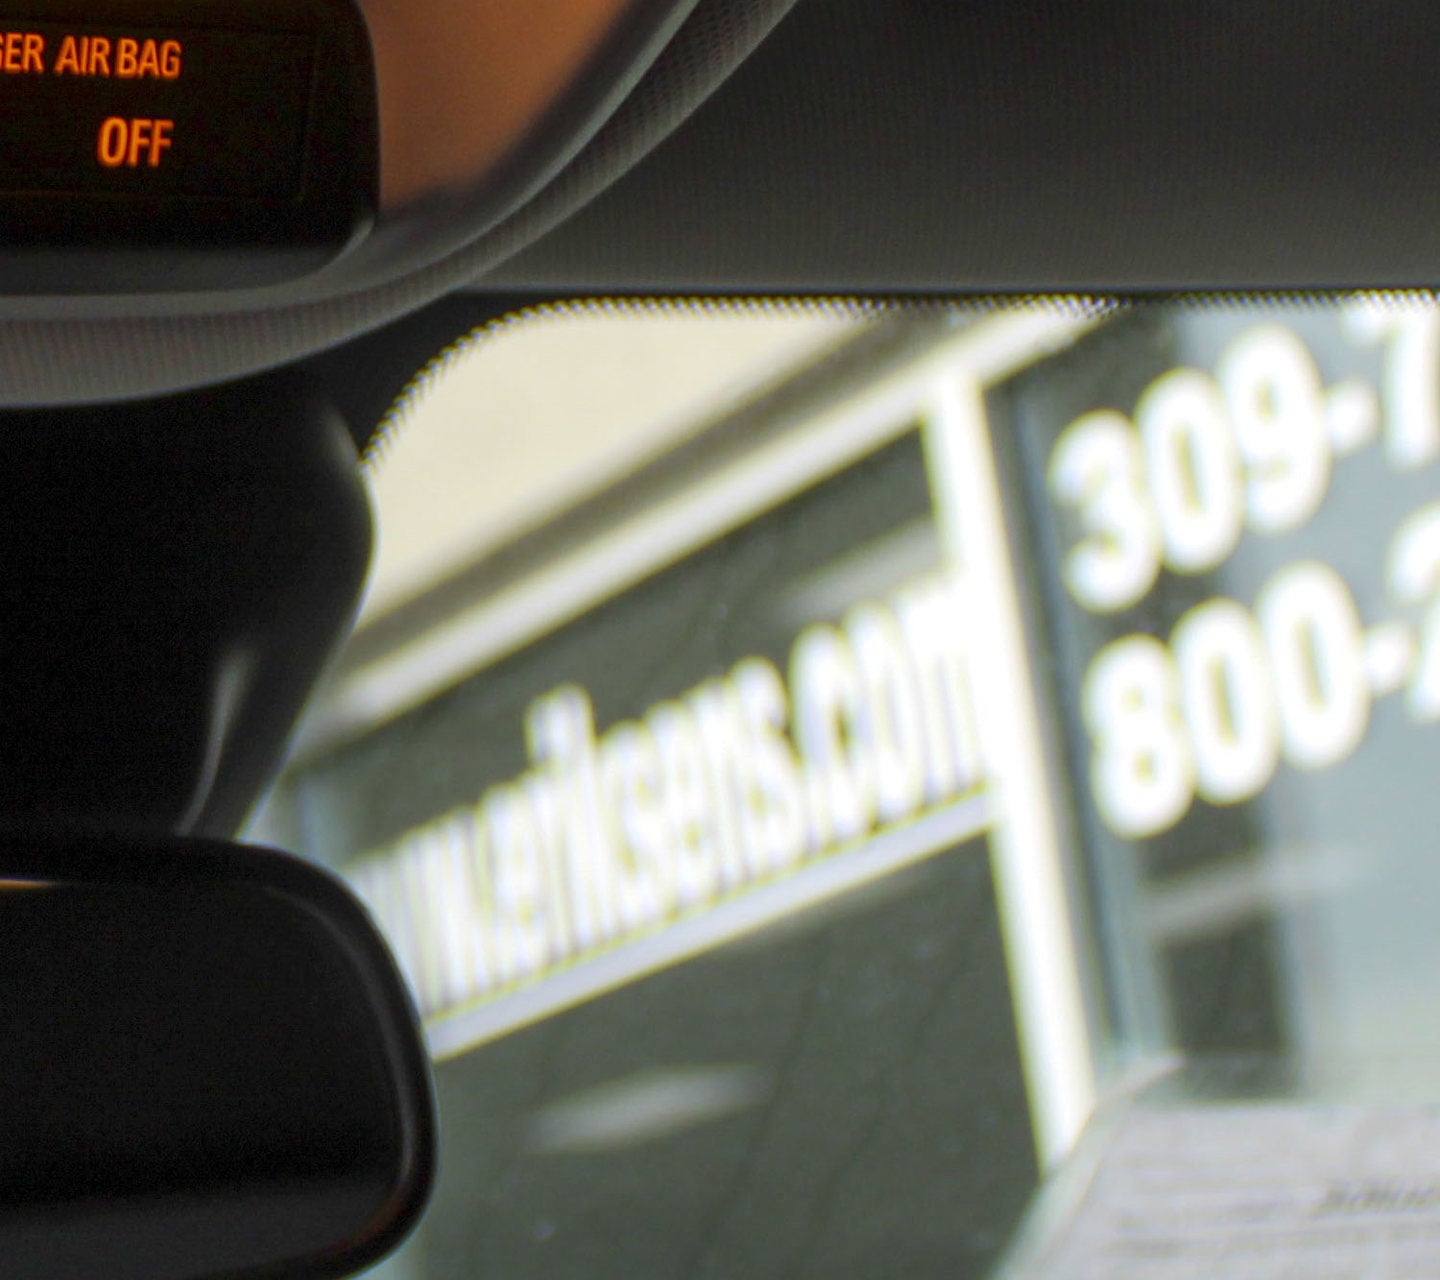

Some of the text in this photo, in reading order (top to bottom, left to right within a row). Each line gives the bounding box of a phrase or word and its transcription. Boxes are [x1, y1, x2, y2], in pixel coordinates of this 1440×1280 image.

[55, 35, 111, 77] AIR
[116, 39, 183, 80] BAG
[97, 116, 175, 168] OFF
